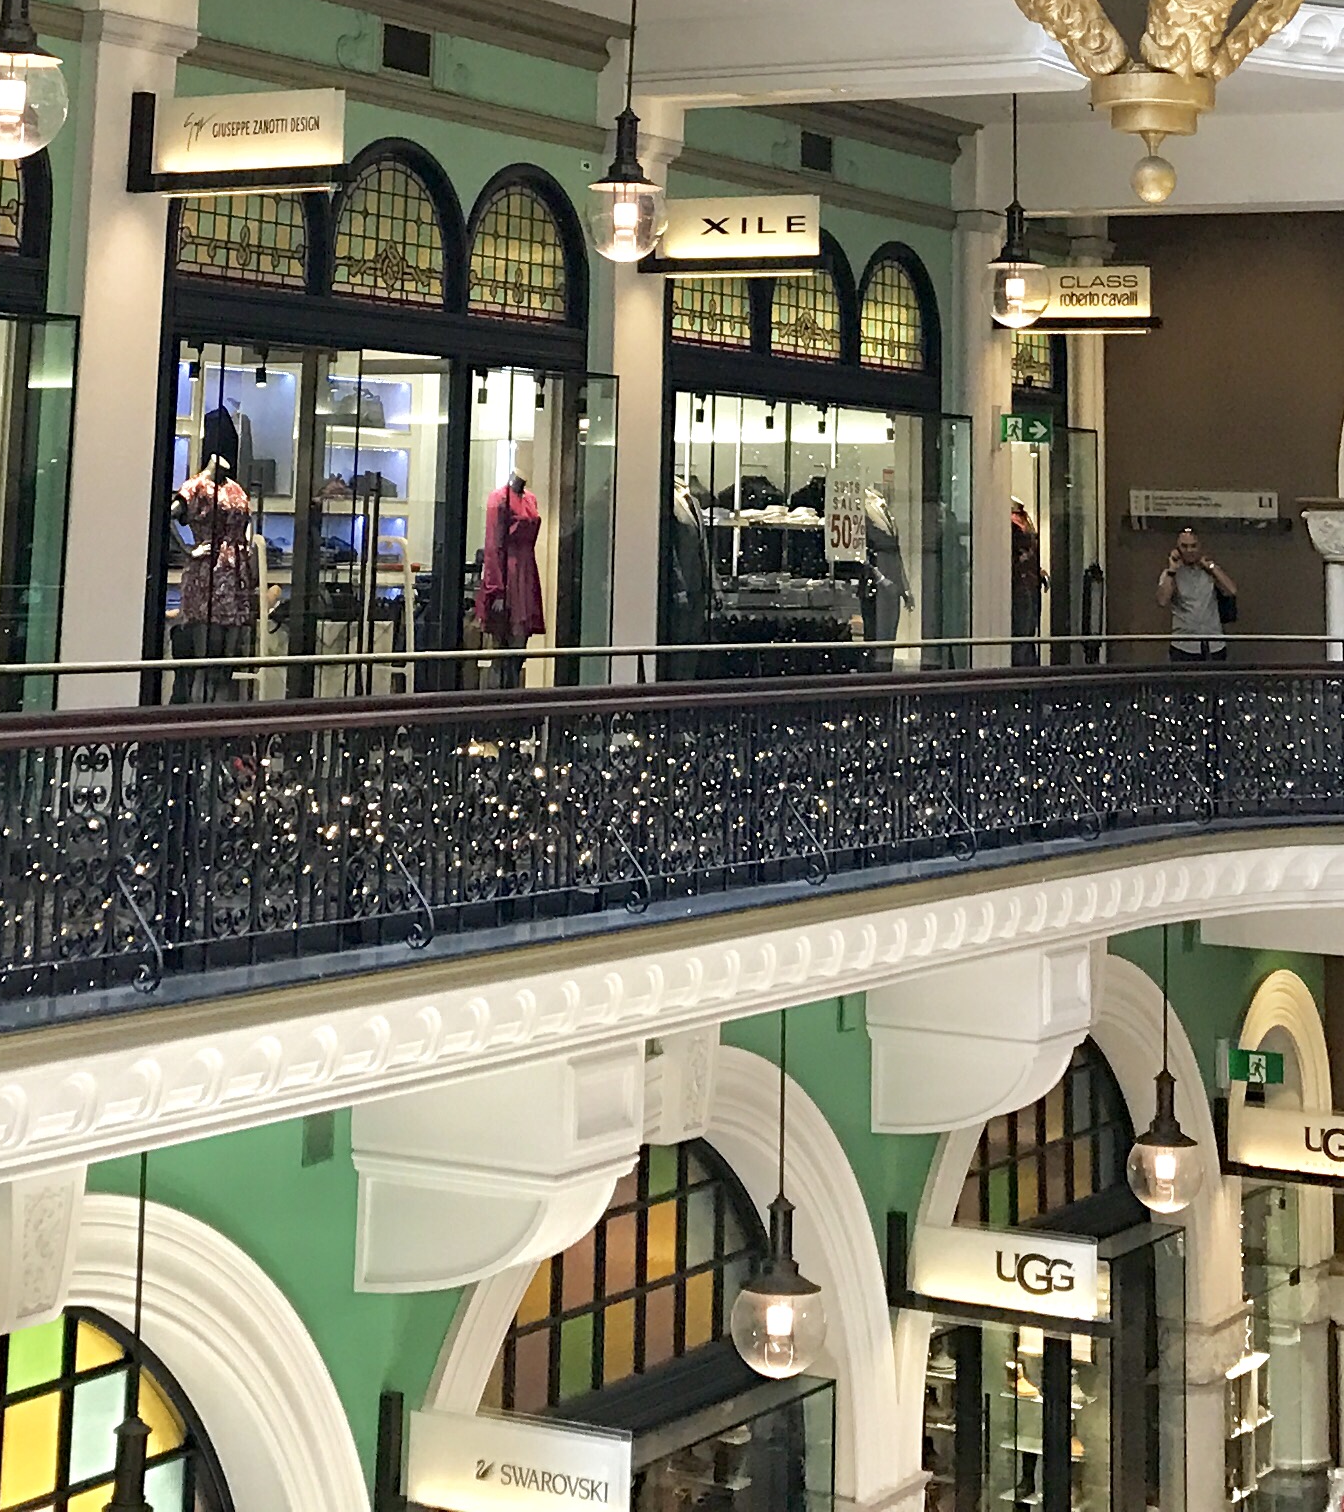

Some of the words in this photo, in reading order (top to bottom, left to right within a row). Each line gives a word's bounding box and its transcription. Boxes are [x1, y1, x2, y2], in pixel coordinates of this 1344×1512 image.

[212, 121, 250, 138] GIUSEPPE
[253, 118, 288, 135] ZANOTTI
[290, 116, 320, 132] DESIGN
[701, 216, 806, 235] XILE
[1060, 275, 1138, 289] CLASS
[1060, 290, 1100, 307] roberto
[1102, 290, 1138, 306] cavalli
[830, 514, 865, 549] 50%
[995, 1250, 1075, 1295] UGG
[500, 1463, 609, 1504] SWAROVSKI
